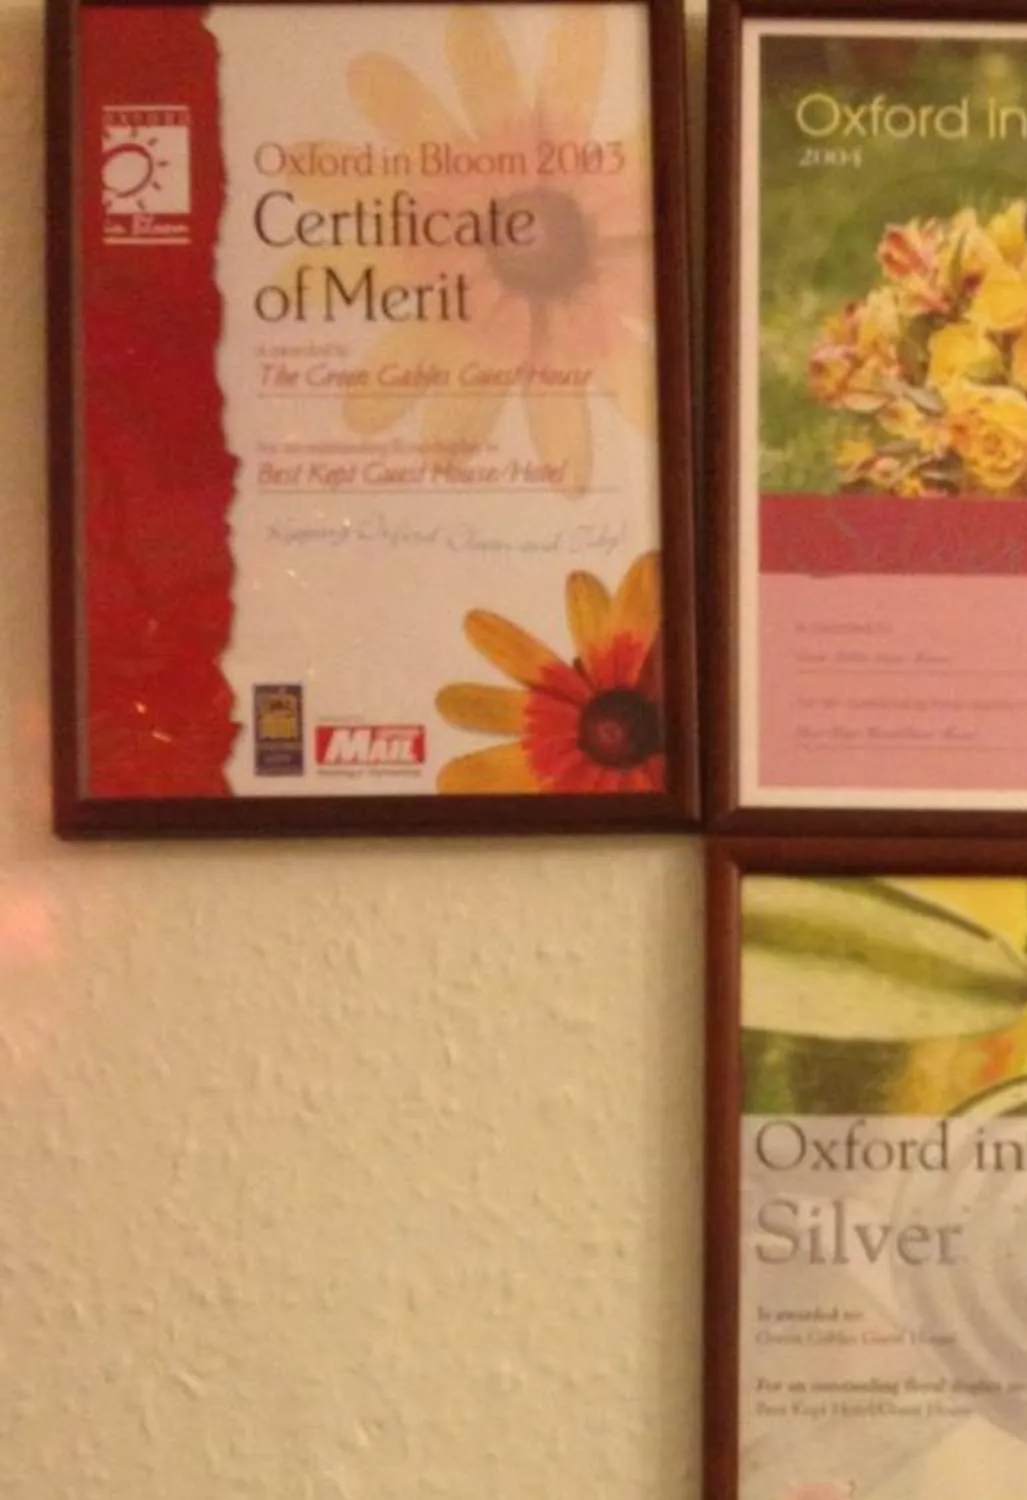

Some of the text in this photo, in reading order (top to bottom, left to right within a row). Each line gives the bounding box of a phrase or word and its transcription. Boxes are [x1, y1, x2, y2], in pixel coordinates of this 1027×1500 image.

[797, 92, 969, 139] Oxford
[254, 141, 373, 177] Oxford
[384, 144, 411, 175] in
[420, 142, 527, 176] Bloom
[254, 190, 537, 248] Certificate
[254, 266, 471, 324] of Merit
[755, 1119, 949, 1174] Oxford
[976, 1120, 1025, 1172] in
[755, 1200, 963, 1267] Silver
